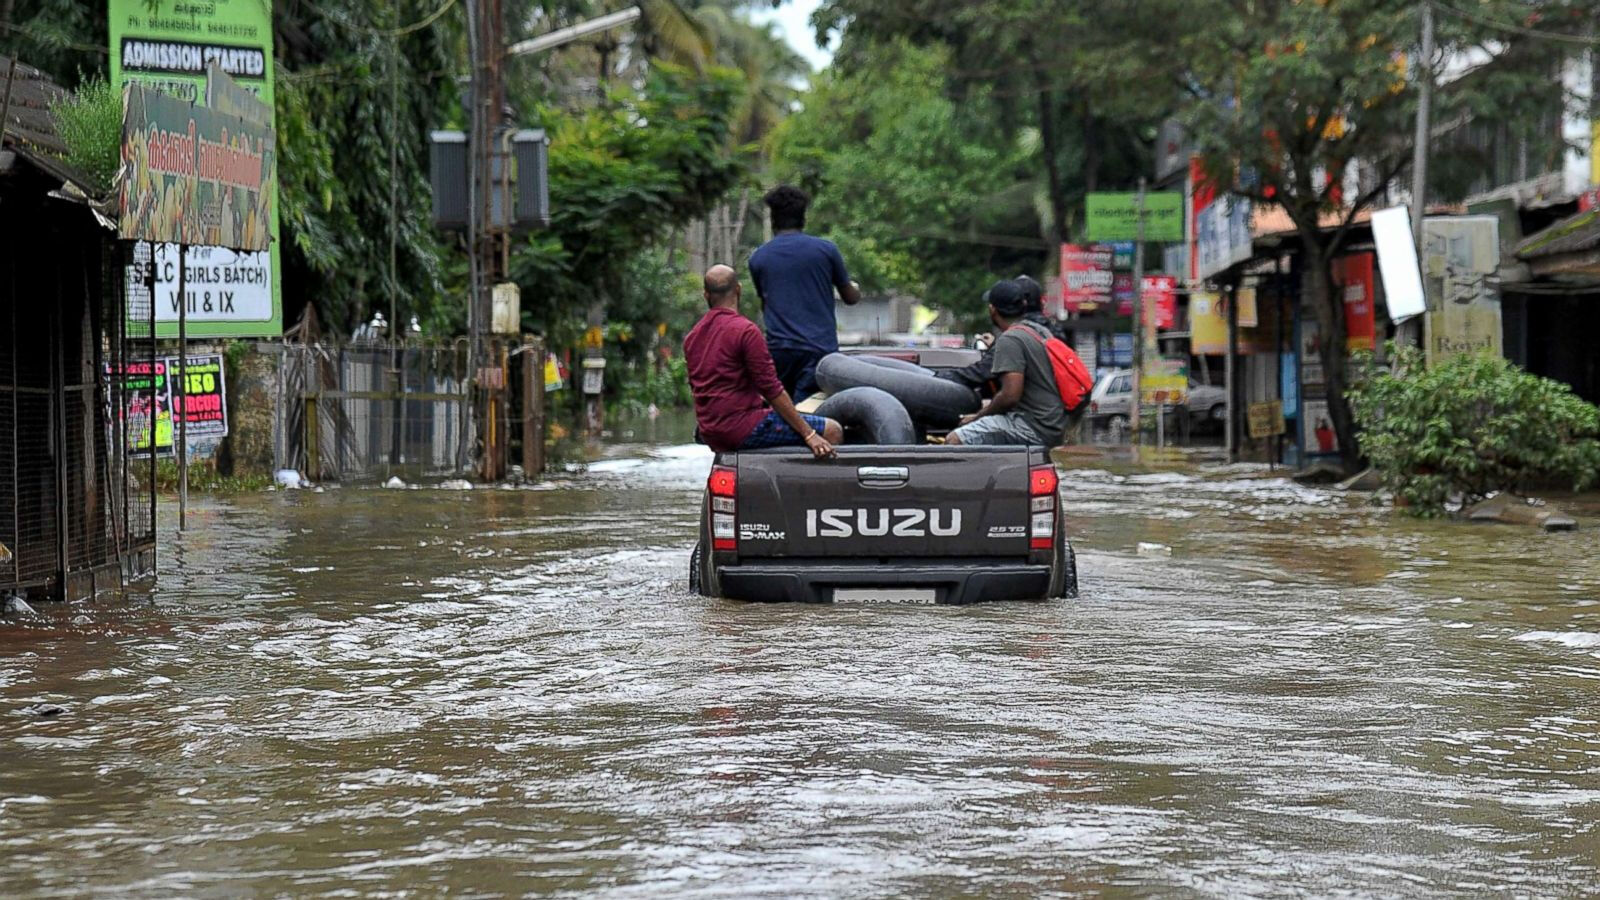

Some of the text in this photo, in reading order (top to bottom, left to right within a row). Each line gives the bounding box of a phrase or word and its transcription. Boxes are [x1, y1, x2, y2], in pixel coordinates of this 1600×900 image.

[123, 42, 264, 76] ADMISSION STARTED
[183, 267, 220, 284] GIRLS
[224, 268, 267, 288] BATCH)
[203, 292, 213, 312] &
[219, 292, 235, 313] IX
[173, 394, 221, 413] CRCUS
[740, 523, 770, 531] ISUZU
[807, 508, 962, 538] ISUZU
